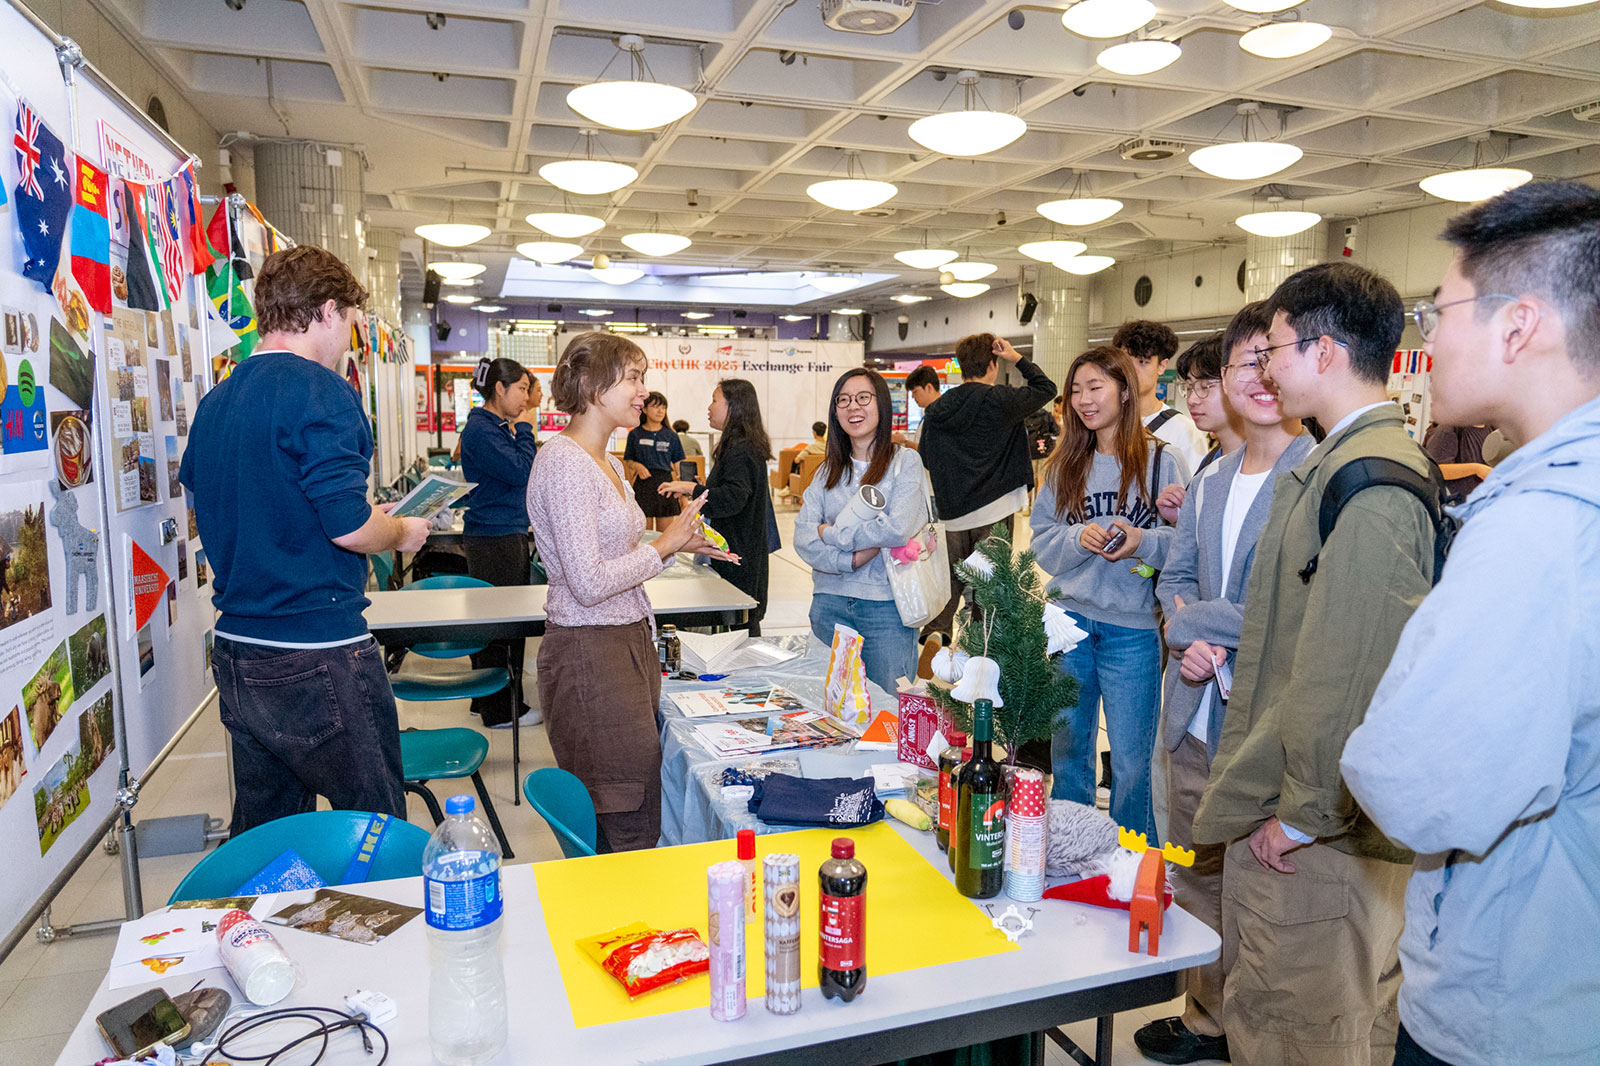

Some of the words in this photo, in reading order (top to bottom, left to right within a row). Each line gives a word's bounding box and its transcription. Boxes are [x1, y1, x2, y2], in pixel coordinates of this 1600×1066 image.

[648, 359, 700, 373] CityUHK
[704, 360, 738, 371] 2025
[743, 361, 804, 374] Exchange
[808, 362, 833, 372] Fair
